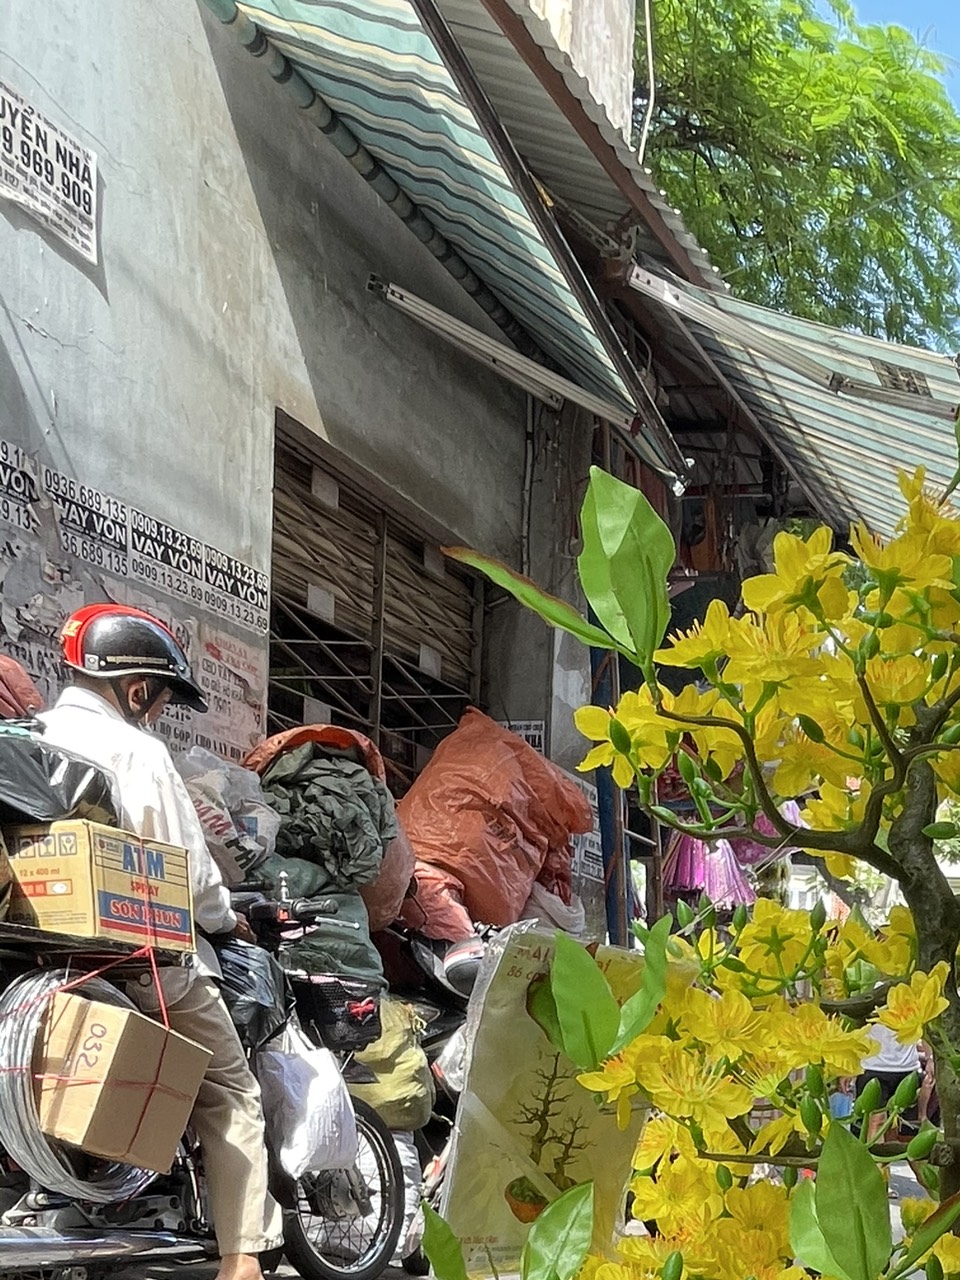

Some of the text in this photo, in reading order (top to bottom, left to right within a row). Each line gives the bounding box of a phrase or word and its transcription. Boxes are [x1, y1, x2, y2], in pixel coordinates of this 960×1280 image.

[45, 468, 127, 523] 0936.689.135
[131, 510, 203, 561] 0909.13.23.69
[132, 532, 165, 561] VAY
[132, 558, 203, 601] 0909.13.23.69
[205, 546, 268, 593] 0909.13.23.69
[206, 566, 235, 593] VAY
[204, 590, 268, 631] 0909.13.23.69
[110, 898, 140, 920] SƠN
[507, 965, 522, 979] 86
[73, 1023, 107, 1077] 032
